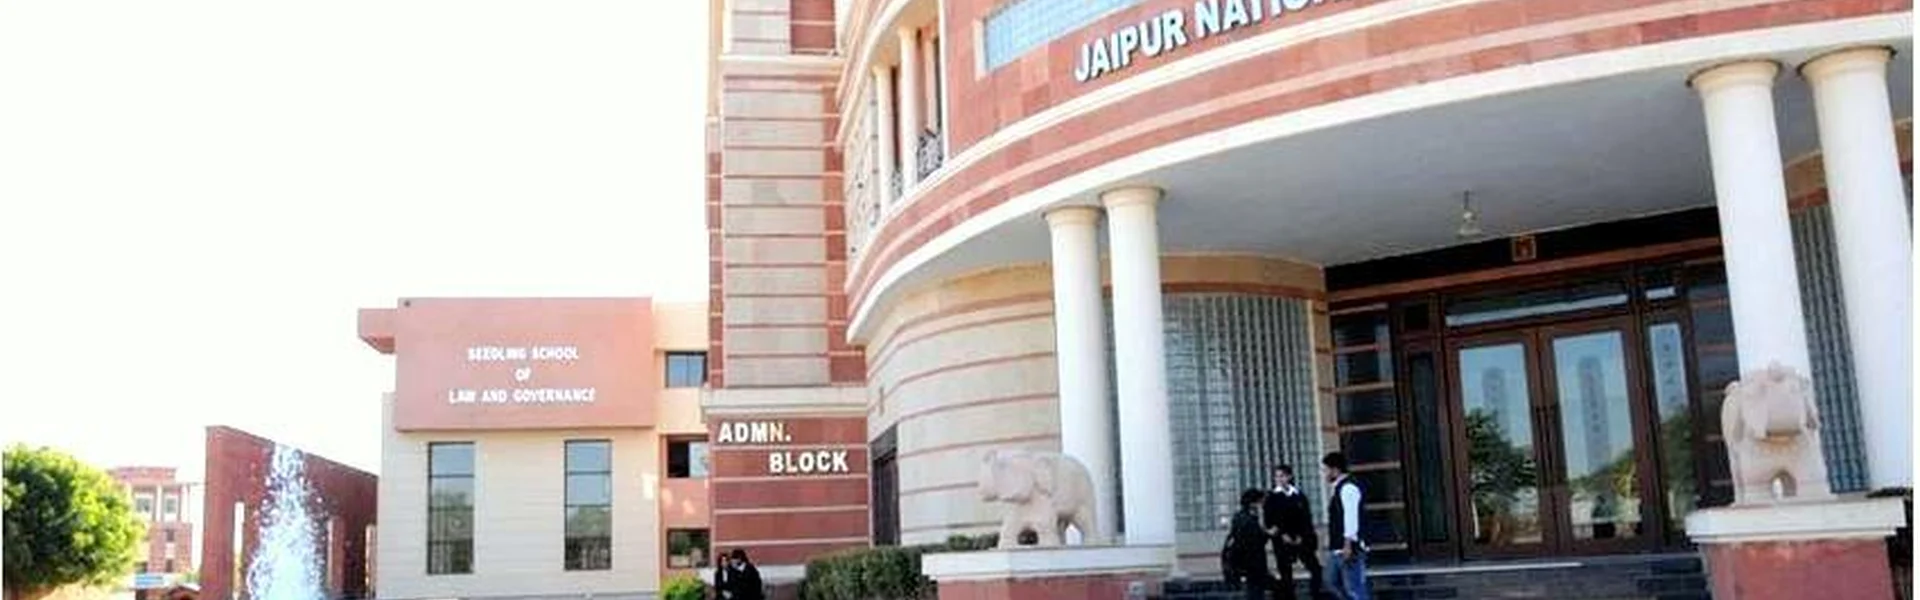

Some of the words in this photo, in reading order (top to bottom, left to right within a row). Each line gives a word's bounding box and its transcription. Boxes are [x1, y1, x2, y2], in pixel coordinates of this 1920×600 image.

[1074, 9, 1187, 82] JAIPUR
[532, 346, 579, 360] SCHOOL
[514, 367, 531, 382] OF
[449, 389, 477, 404] LAW
[482, 388, 508, 403] AND
[512, 387, 596, 403] GOVERNANCE
[718, 421, 792, 443] ADMN.
[769, 451, 849, 473] BLOCK
